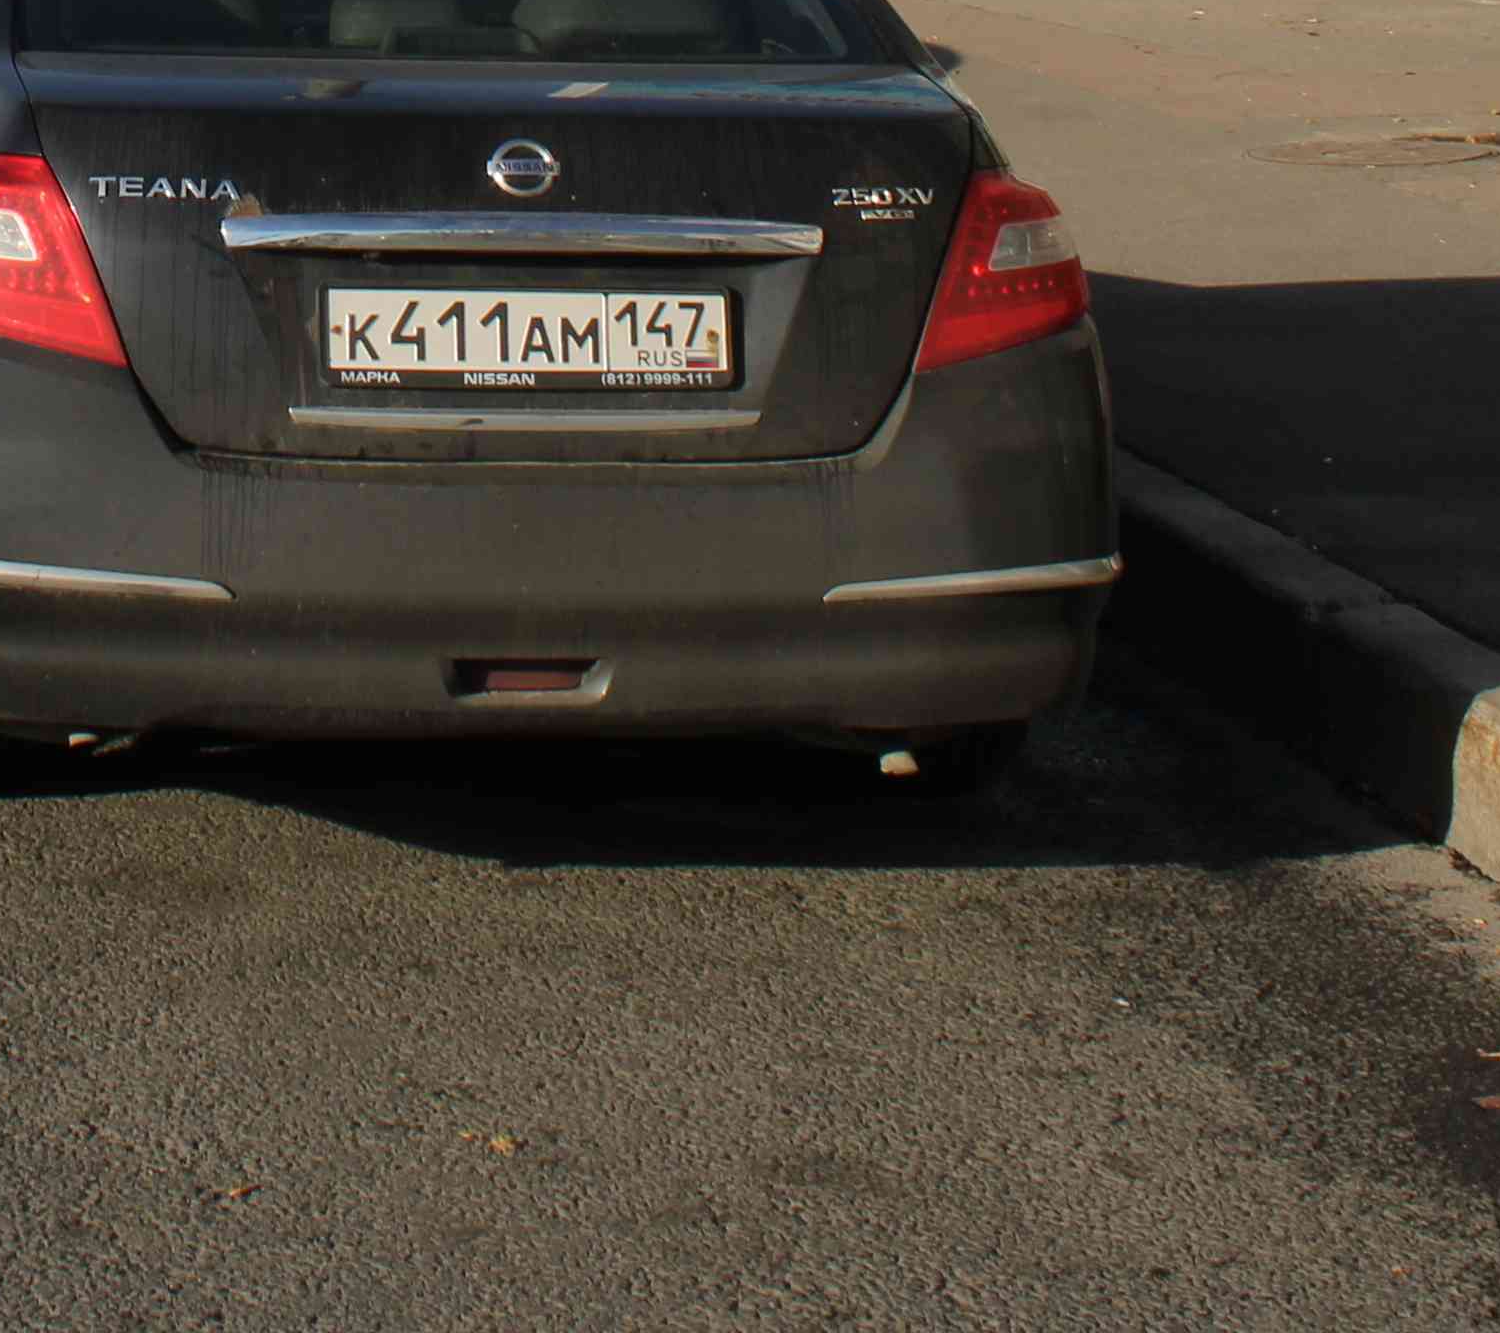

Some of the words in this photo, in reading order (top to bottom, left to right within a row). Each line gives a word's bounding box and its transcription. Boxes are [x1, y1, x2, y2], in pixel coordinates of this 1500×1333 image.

[89, 176, 241, 201] TEANA
[831, 187, 893, 205] 250
[895, 186, 933, 205] XV
[345, 300, 600, 363] К411АМ
[613, 300, 705, 348] 147
[637, 349, 683, 367] RUS
[464, 372, 536, 385] NISSAN
[600, 372, 641, 386] (812)
[643, 372, 713, 385] 9999-111
